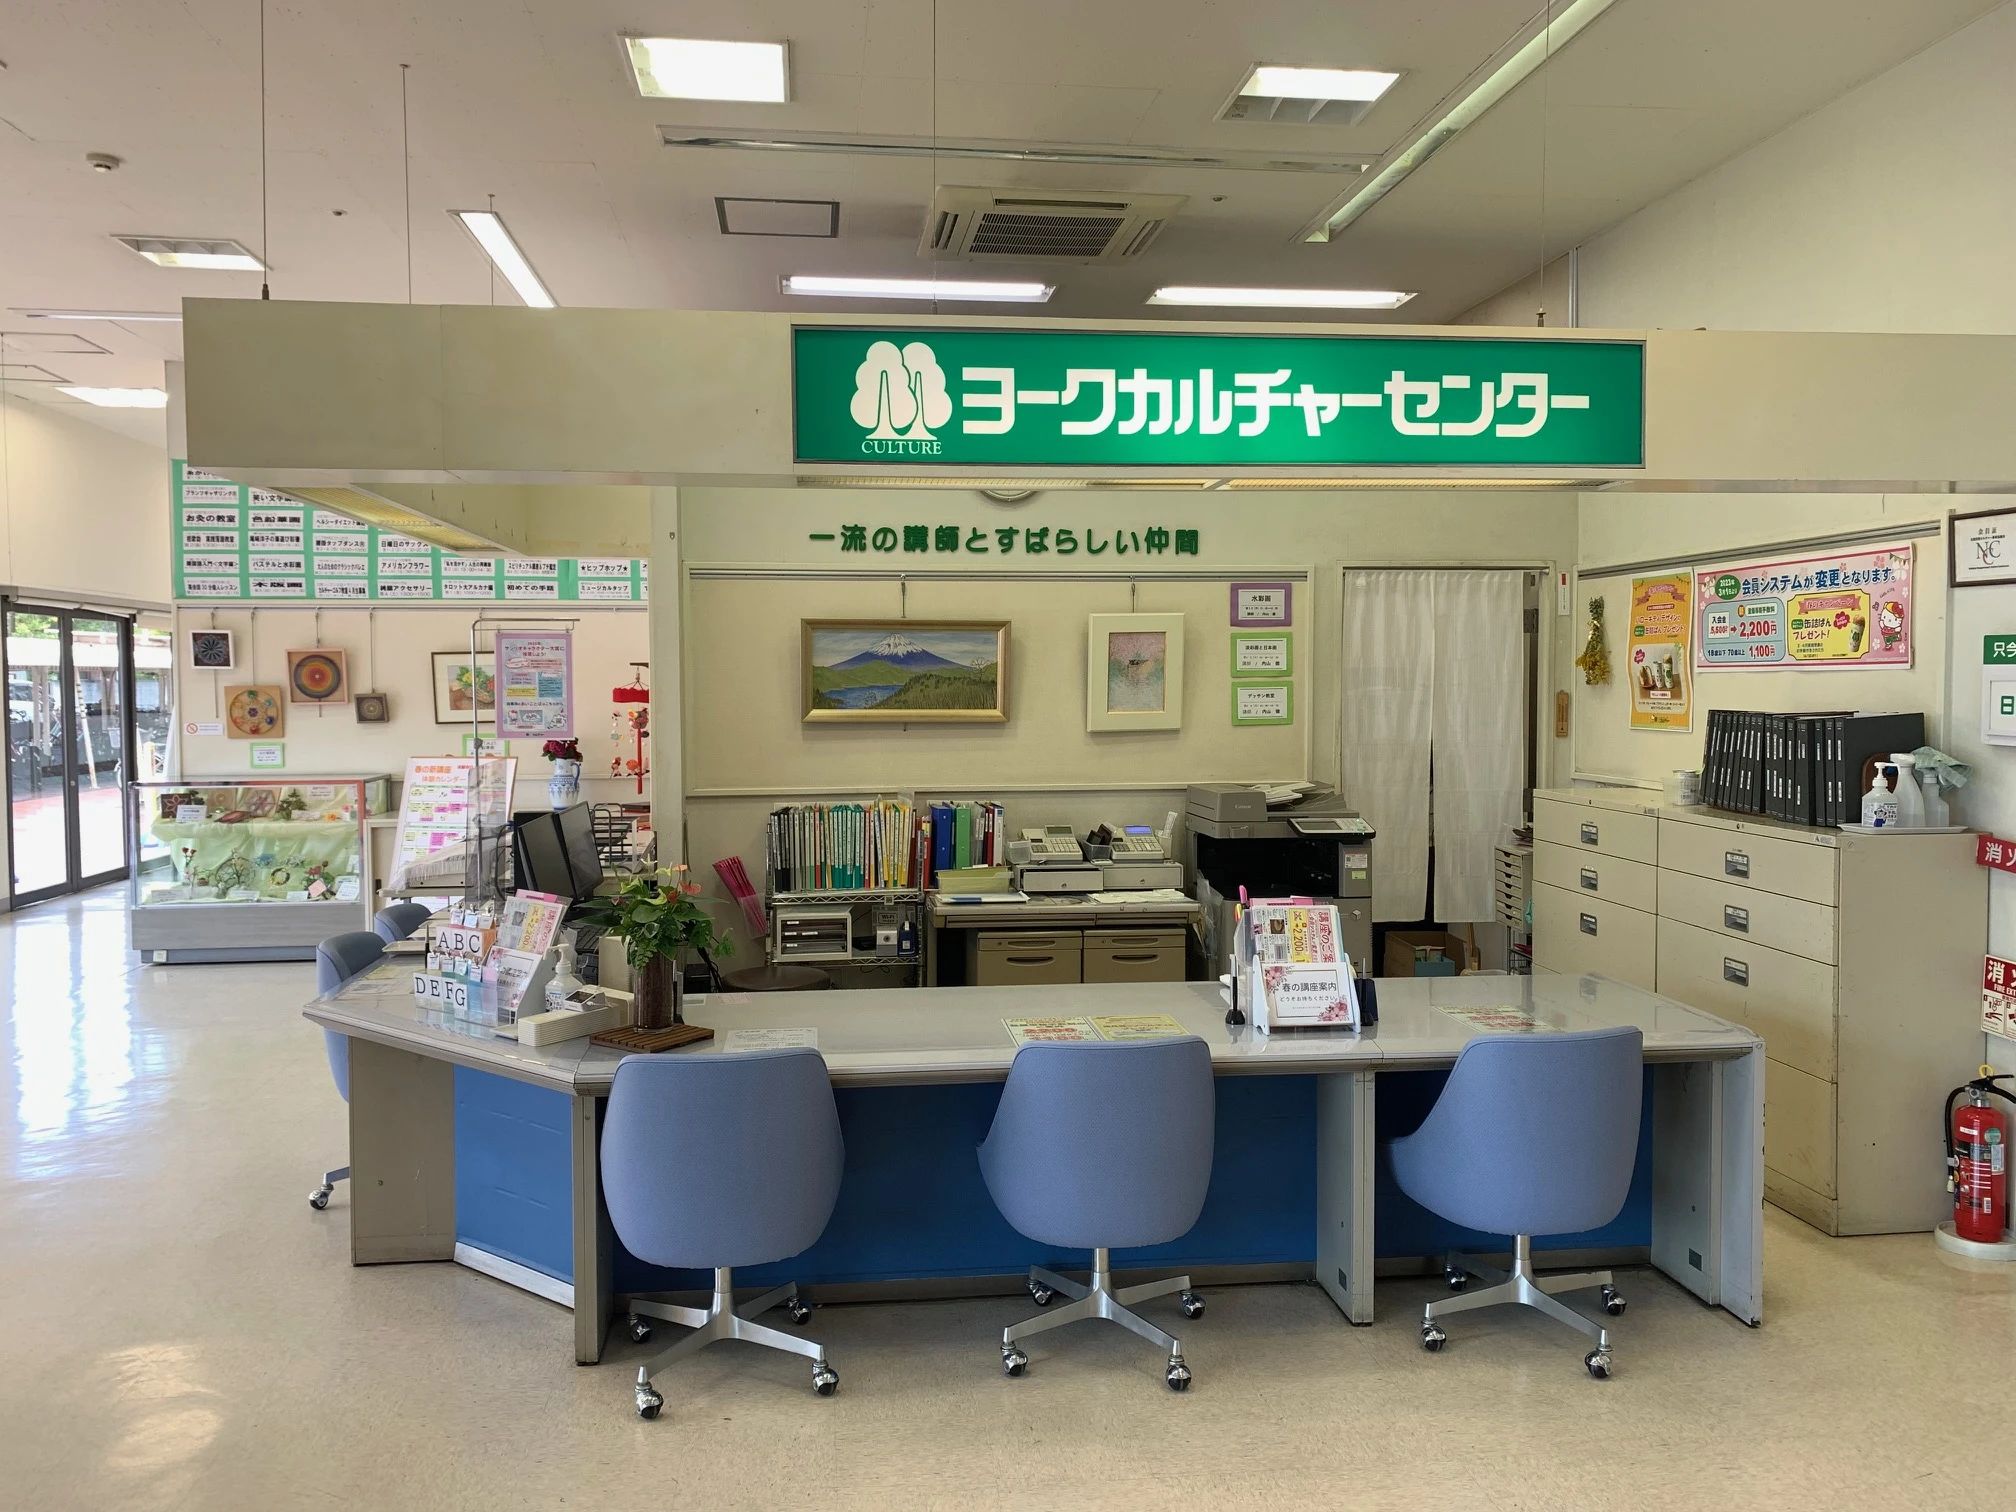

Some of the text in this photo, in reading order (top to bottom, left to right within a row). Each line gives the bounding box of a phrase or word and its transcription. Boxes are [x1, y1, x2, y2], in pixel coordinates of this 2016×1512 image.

[962, 367, 1590, 438] ヨークカルチャーセンター
[861, 440, 943, 455] CULTURE
[186, 514, 236, 523] お灸の教室
[809, 524, 1200, 555] 一流の講師とすばらしい仲間
[1741, 567, 1896, 595] 会員システムが変更となります。
[1711, 616, 1727, 624] 入会金
[1740, 620, 1777, 639] 2,200円
[1748, 645, 1776, 659] 1,100円
[438, 932, 480, 953] A B C
[415, 976, 466, 1007] D E F G
[1282, 982, 1337, 992] 春の講座案内
[1993, 983, 2006, 993] FIRE
